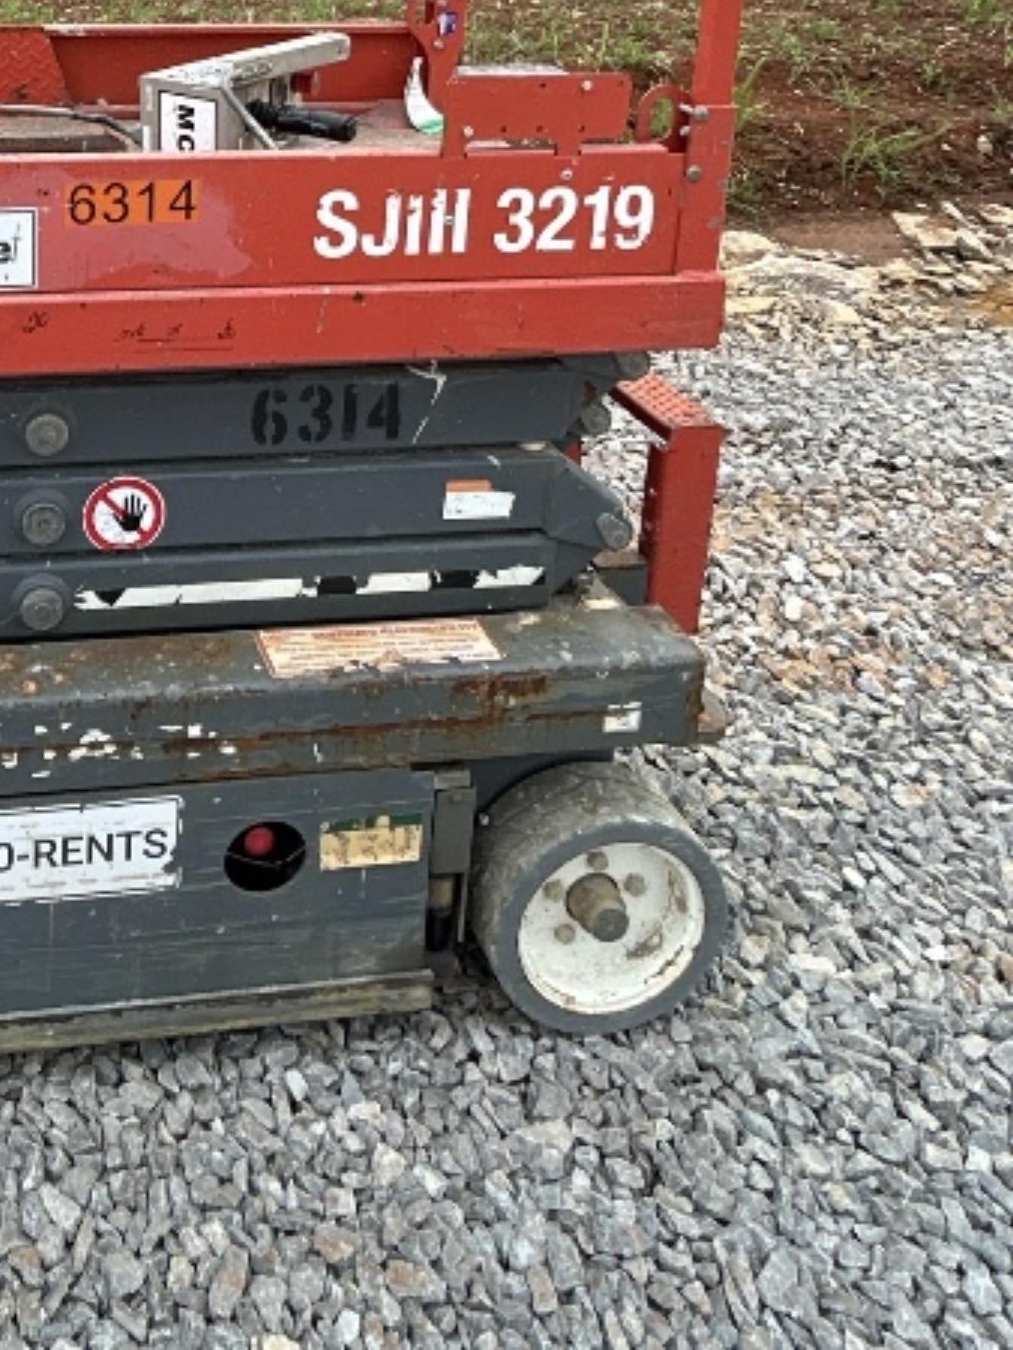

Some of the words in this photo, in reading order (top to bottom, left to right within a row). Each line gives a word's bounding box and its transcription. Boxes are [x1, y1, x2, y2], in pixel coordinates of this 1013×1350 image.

[69, 179, 196, 226] 6314
[492, 184, 655, 253] 3219
[251, 380, 401, 446] 6314
